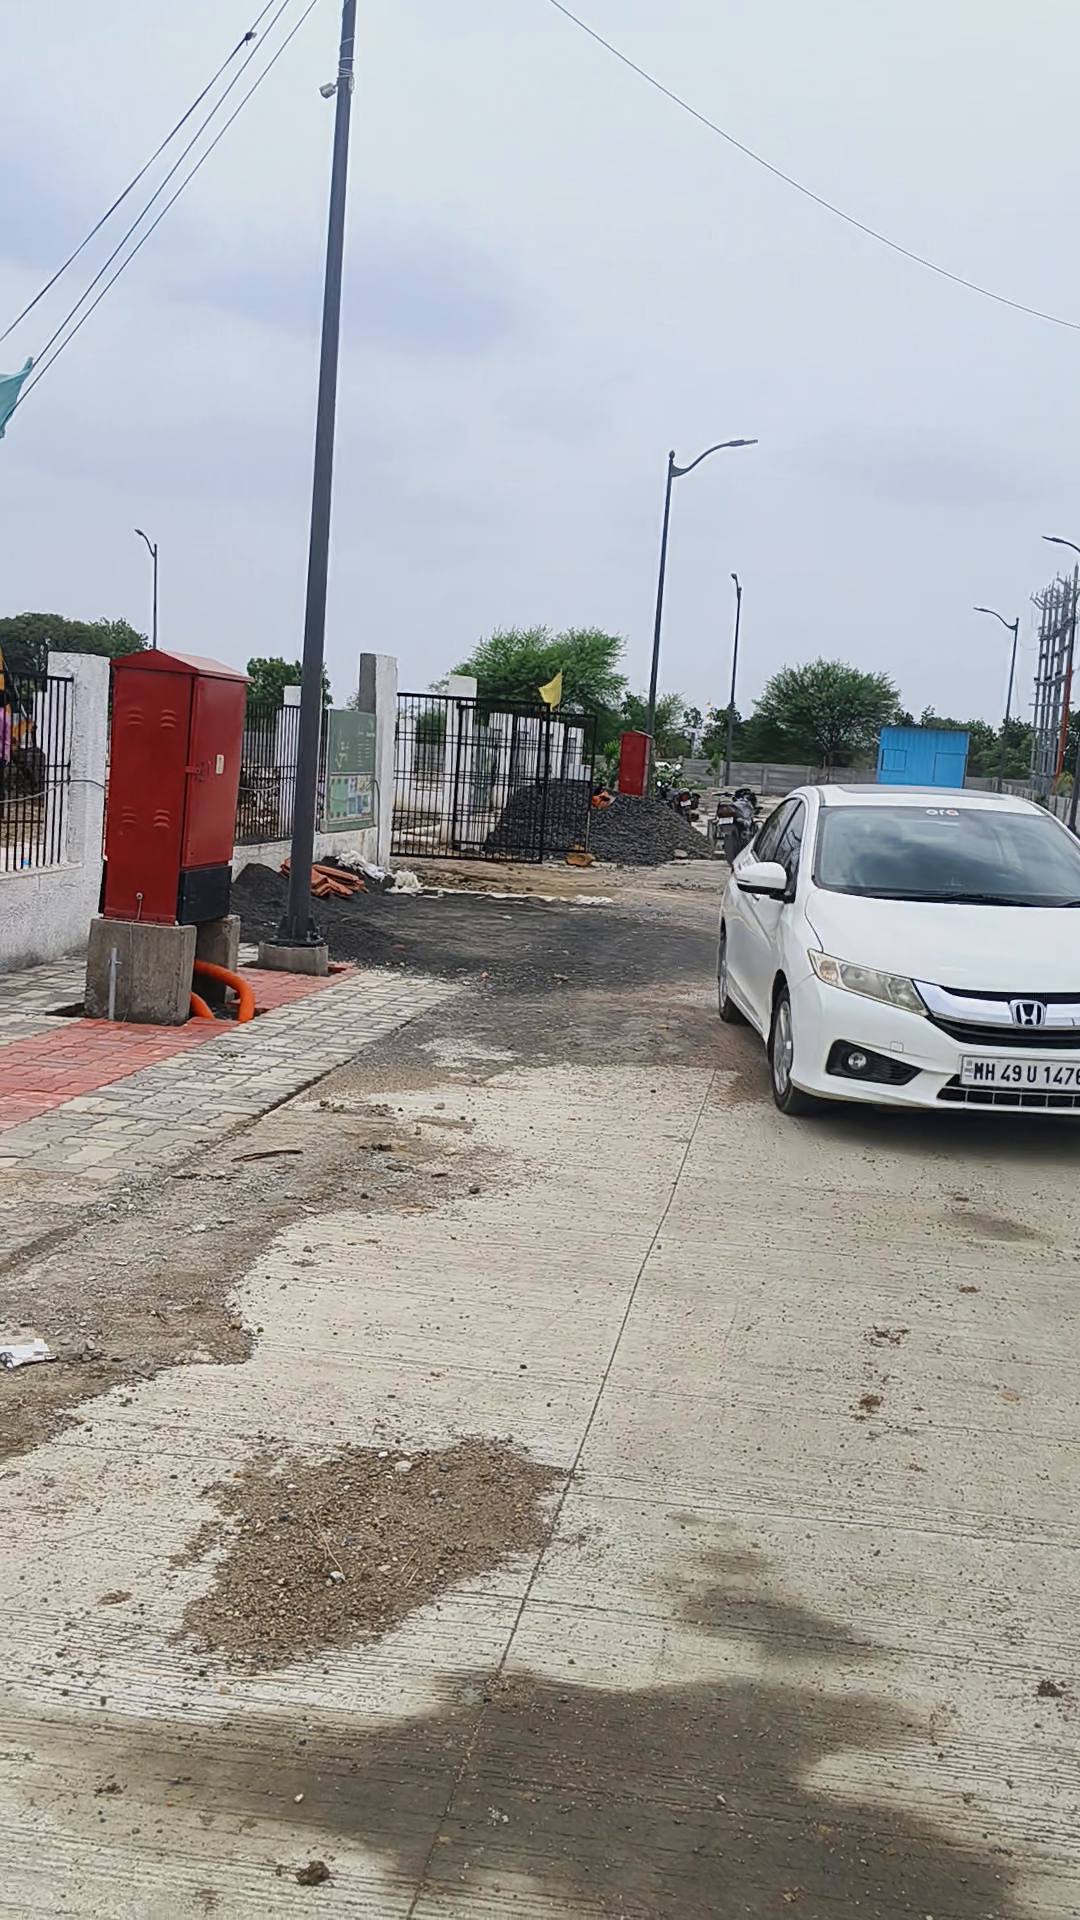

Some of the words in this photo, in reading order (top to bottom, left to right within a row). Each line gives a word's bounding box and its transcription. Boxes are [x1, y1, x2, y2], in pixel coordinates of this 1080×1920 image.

[973, 1062, 995, 1081] MH
[1001, 1064, 1022, 1082] 49
[1027, 1065, 1037, 1083] U
